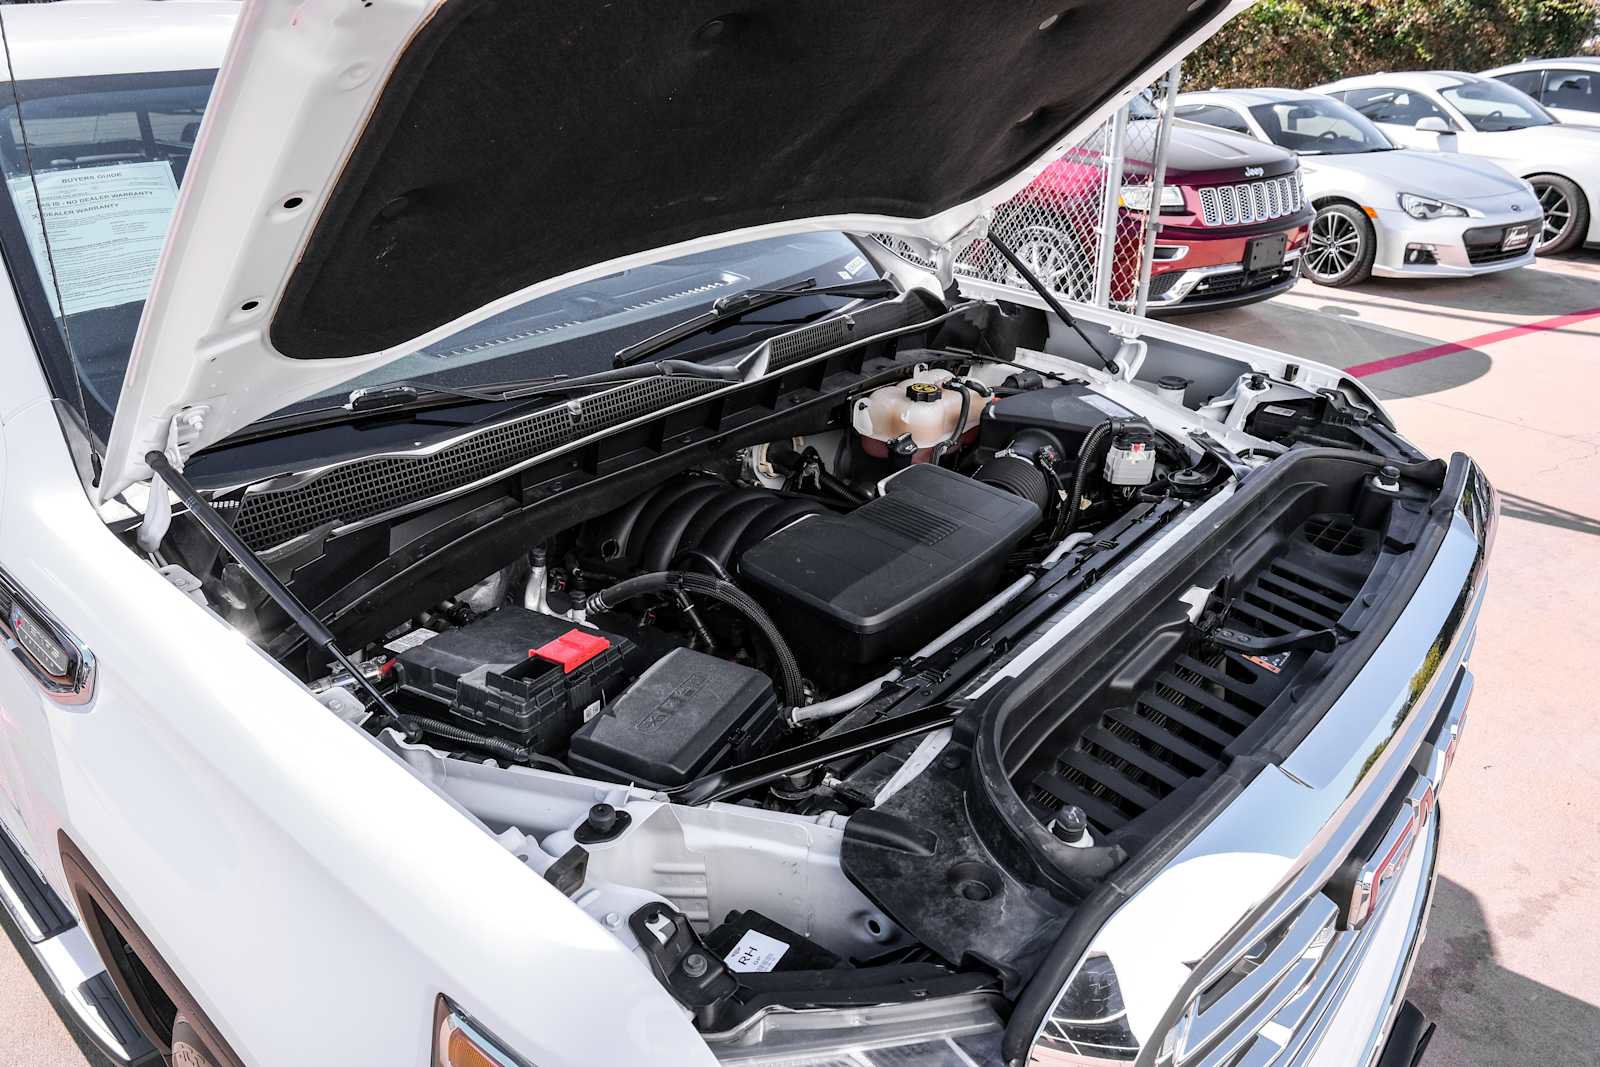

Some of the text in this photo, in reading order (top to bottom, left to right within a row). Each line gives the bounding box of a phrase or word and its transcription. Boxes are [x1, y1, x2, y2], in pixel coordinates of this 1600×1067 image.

[62, 172, 122, 183] BUYERS GUIDE
[1245, 166, 1264, 177] Jeep
[79, 194, 110, 204] DEALER
[111, 190, 153, 199] WARRANTY
[44, 203, 119, 218] DEALER WARRANTY
[738, 946, 758, 965] RH
